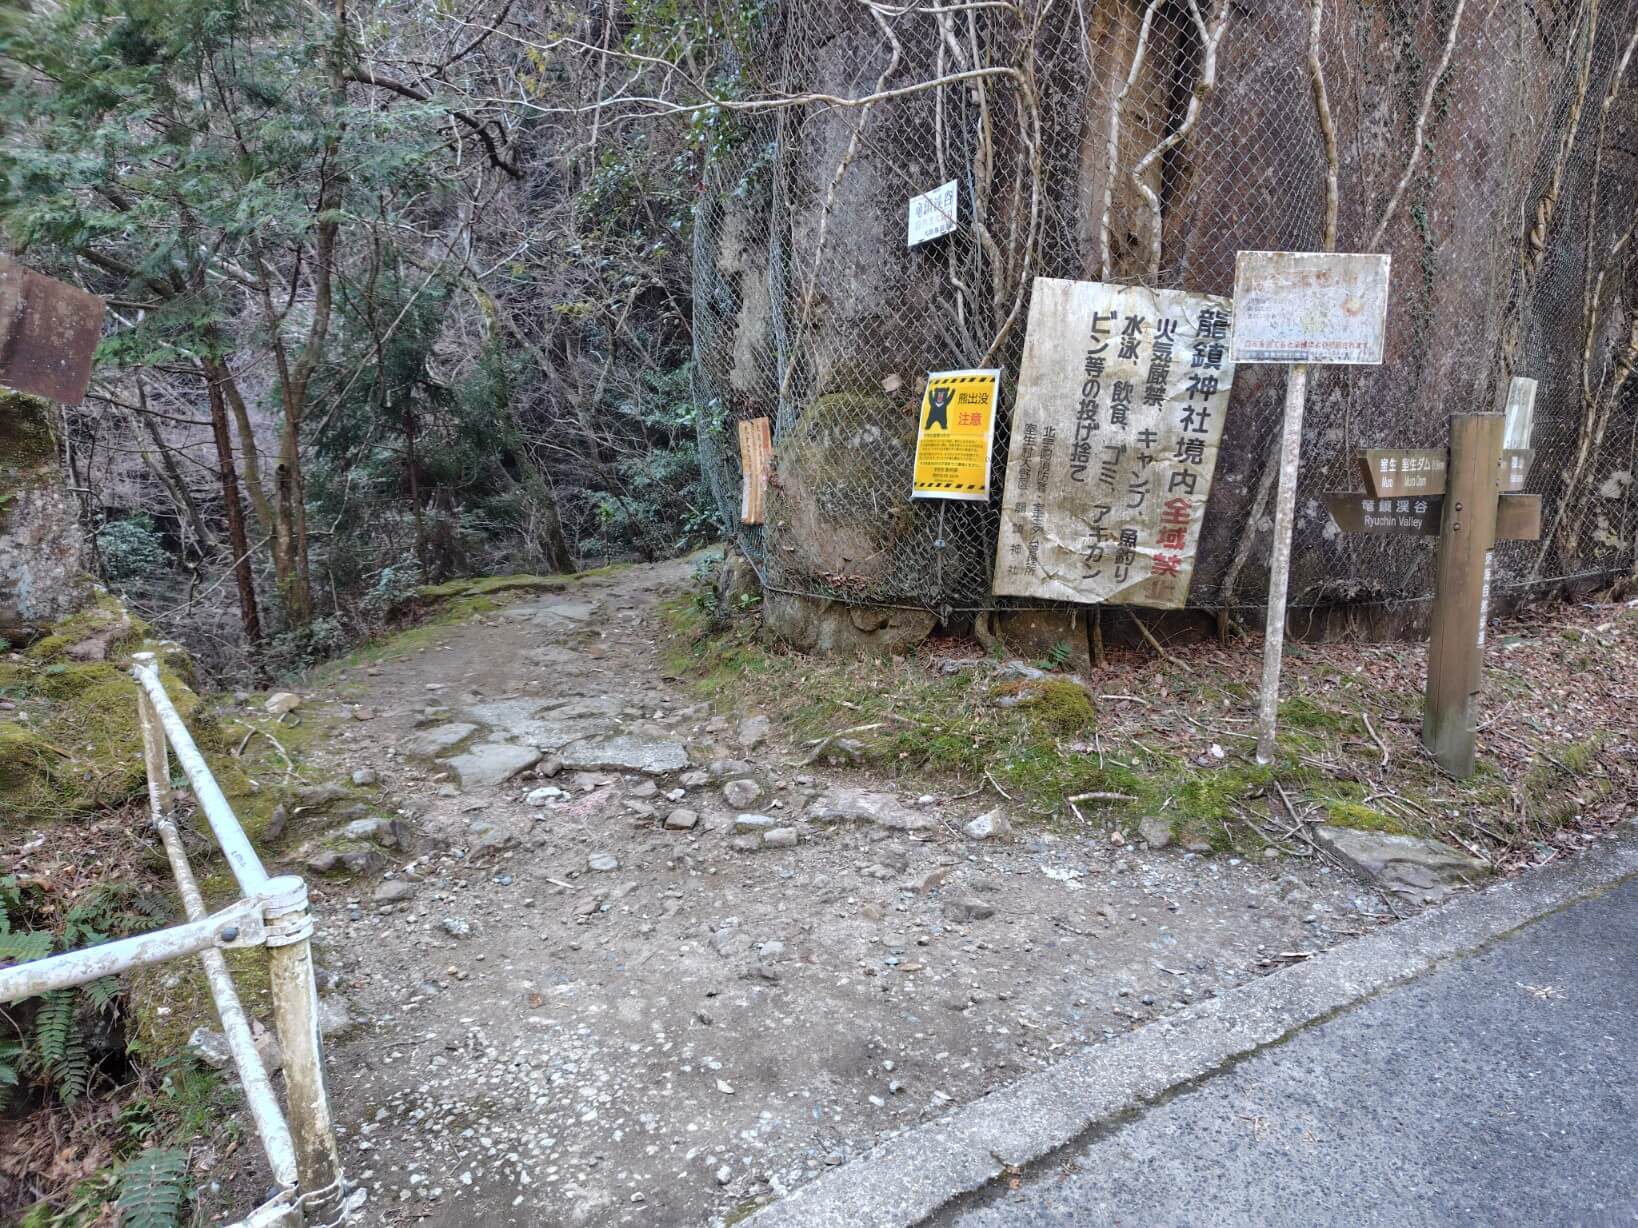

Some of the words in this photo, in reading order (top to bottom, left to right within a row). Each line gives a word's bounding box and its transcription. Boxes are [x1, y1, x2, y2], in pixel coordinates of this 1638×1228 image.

[958, 393, 989, 405] 熊出没
[1069, 311, 1117, 483] ビン等の投げ捨て
[958, 412, 982, 426] 注意
[1364, 515, 1396, 528] Ryuchin
[1398, 516, 1423, 529] Valley
